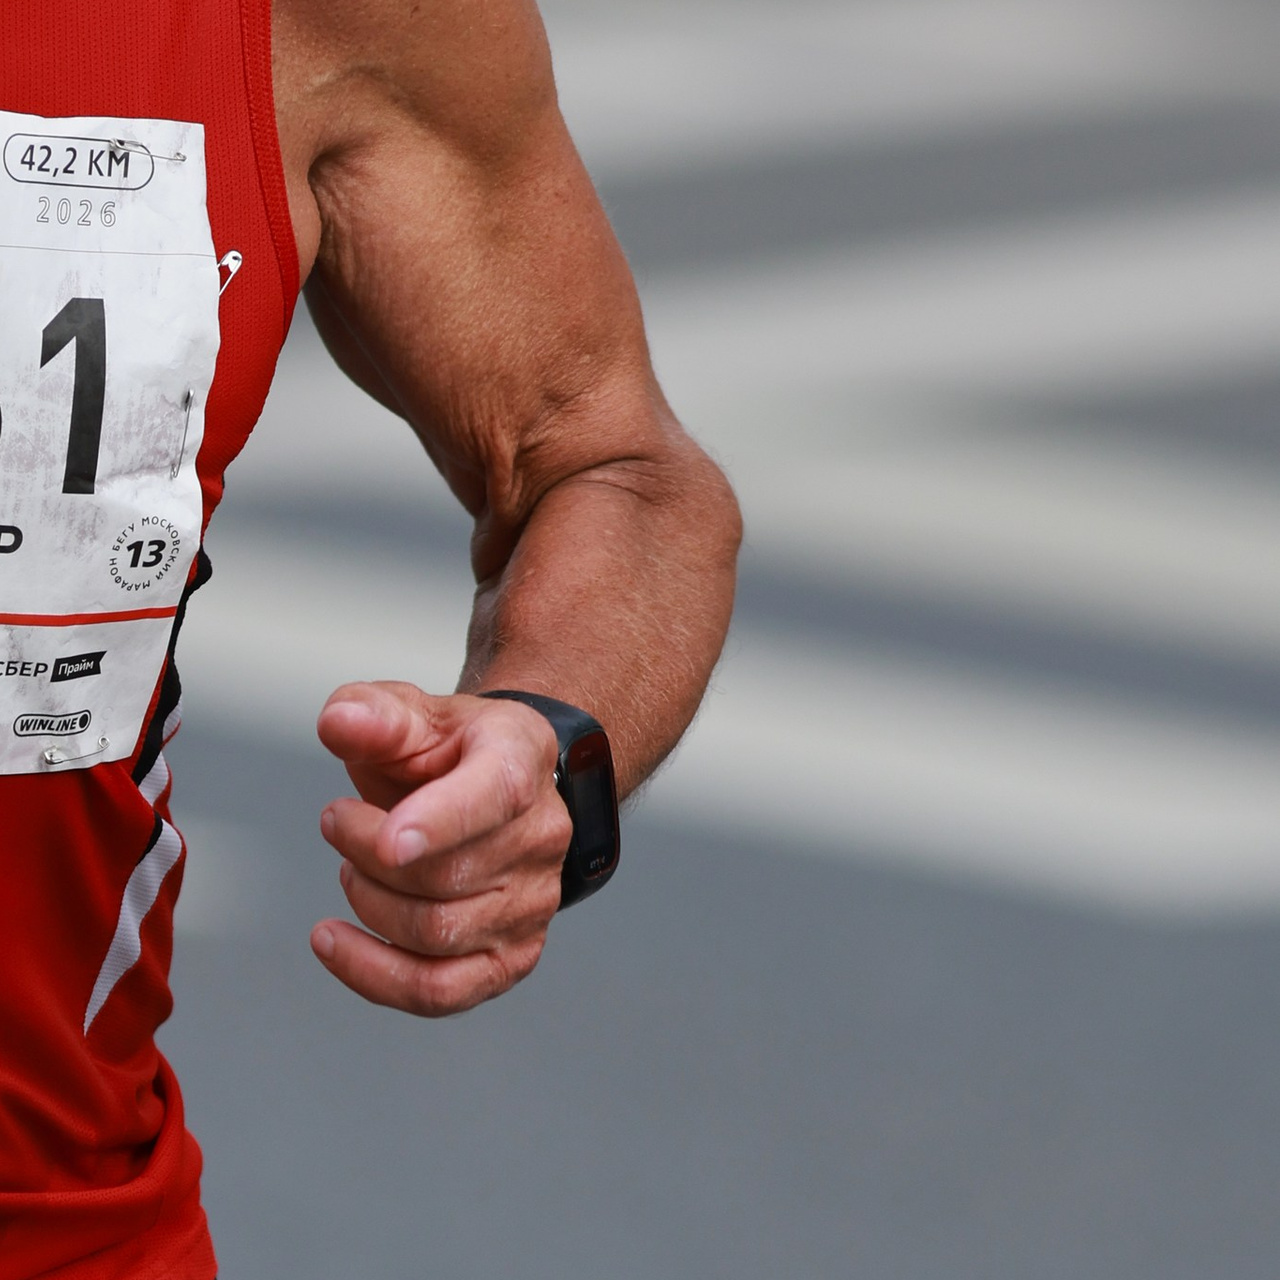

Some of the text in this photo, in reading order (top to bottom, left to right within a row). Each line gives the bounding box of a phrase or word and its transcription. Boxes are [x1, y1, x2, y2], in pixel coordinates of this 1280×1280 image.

[20, 144, 131, 179] 42,2 КМ
[36, 196, 117, 227] 2026
[109, 516, 181, 591] БЕГУ МОСКОВСКИЙ МАРАФОН
[126, 540, 166, 568] 13
[58, 659, 94, 677] Прайм
[20, 717, 78, 732] WINLINE
